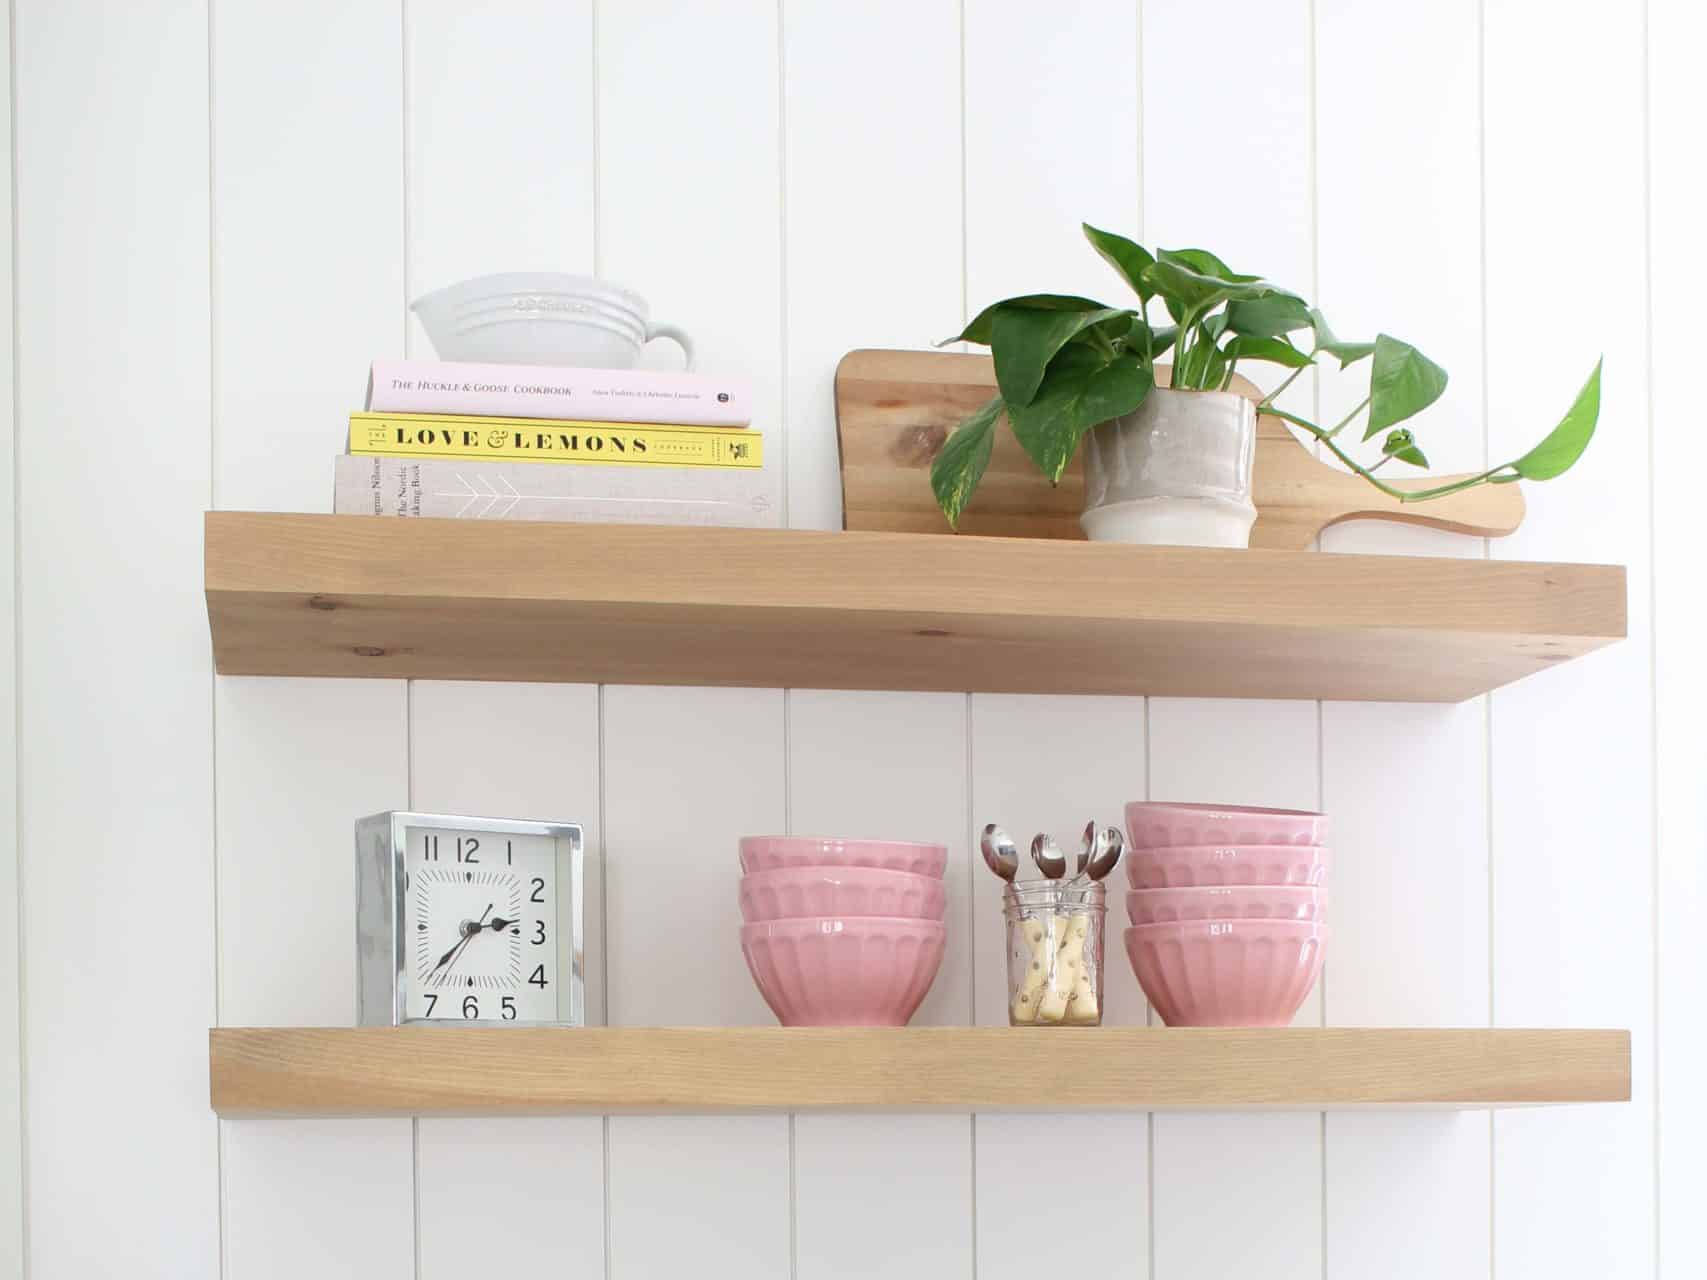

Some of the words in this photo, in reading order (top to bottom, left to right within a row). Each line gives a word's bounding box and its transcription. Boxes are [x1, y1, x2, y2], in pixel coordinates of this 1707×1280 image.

[513, 384, 572, 396] COOKBOOK
[396, 428, 479, 447] LOVE
[487, 430, 508, 449] &
[514, 432, 647, 453] LEMONS
[411, 489, 424, 516] aking
[425, 835, 438, 861] 11
[458, 837, 480, 863] 12
[507, 840, 512, 865] 1
[530, 877, 545, 903] 2
[530, 920, 546, 945] 3
[528, 964, 549, 989] 4
[424, 994, 438, 1018] 7
[462, 996, 479, 1020] 6
[501, 996, 517, 1021] 5
